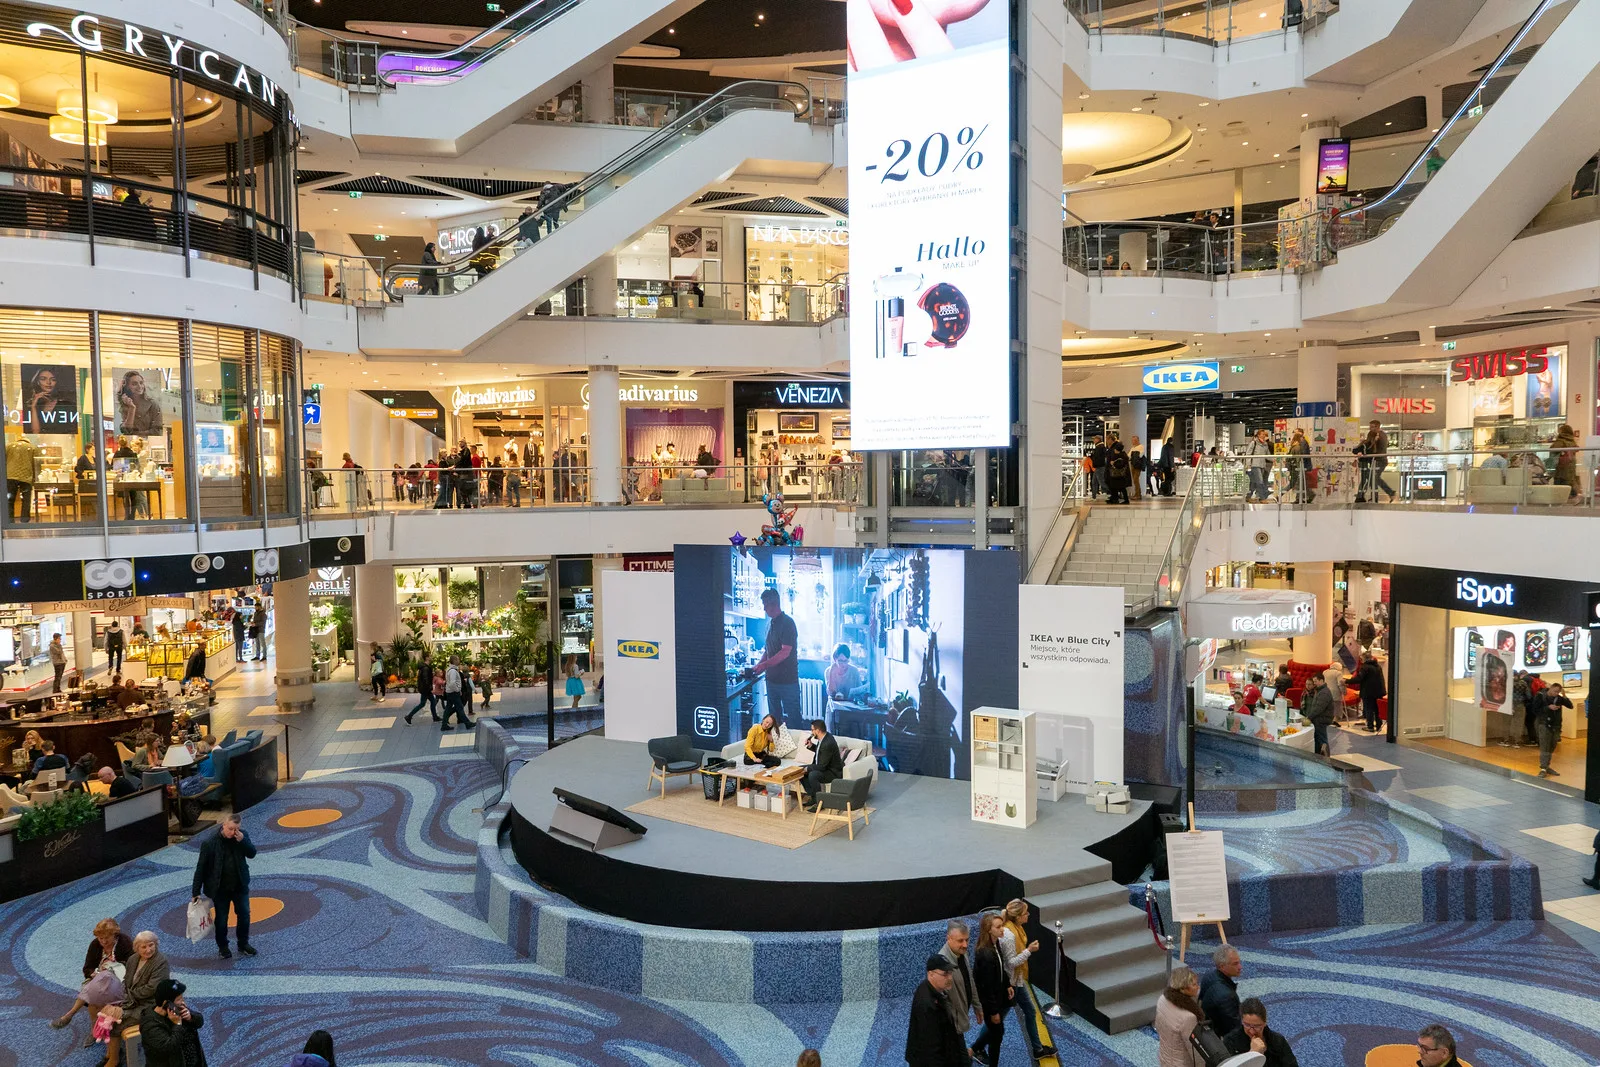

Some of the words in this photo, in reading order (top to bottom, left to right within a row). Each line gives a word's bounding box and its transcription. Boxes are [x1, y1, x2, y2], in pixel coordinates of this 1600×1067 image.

[27, 15, 276, 106] GRYCAN
[866, 123, 989, 184] -20%
[917, 236, 986, 262] Hallo
[1450, 347, 1549, 383] SWISS
[1153, 371, 1210, 384] IKEA
[776, 387, 843, 404] VENEZIA
[1373, 397, 1436, 414] SWISS
[254, 548, 280, 576] GO
[645, 560, 674, 570] TIME
[85, 559, 133, 590] GO
[255, 576, 279, 585] SPORT
[87, 590, 133, 600] SPORT
[1456, 577, 1515, 607] iSpot
[1232, 612, 1310, 633] redberry
[1030, 634, 1053, 643] IKEA
[1068, 636, 1089, 644] Blue
[1092, 638, 1110, 647] City
[623, 645, 655, 654] IKEA
[1031, 645, 1058, 653] Miejsce,
[1061, 646, 1080, 654] które
[1070, 655, 1110, 664] odpowiada.
[700, 719, 714, 729] 25
